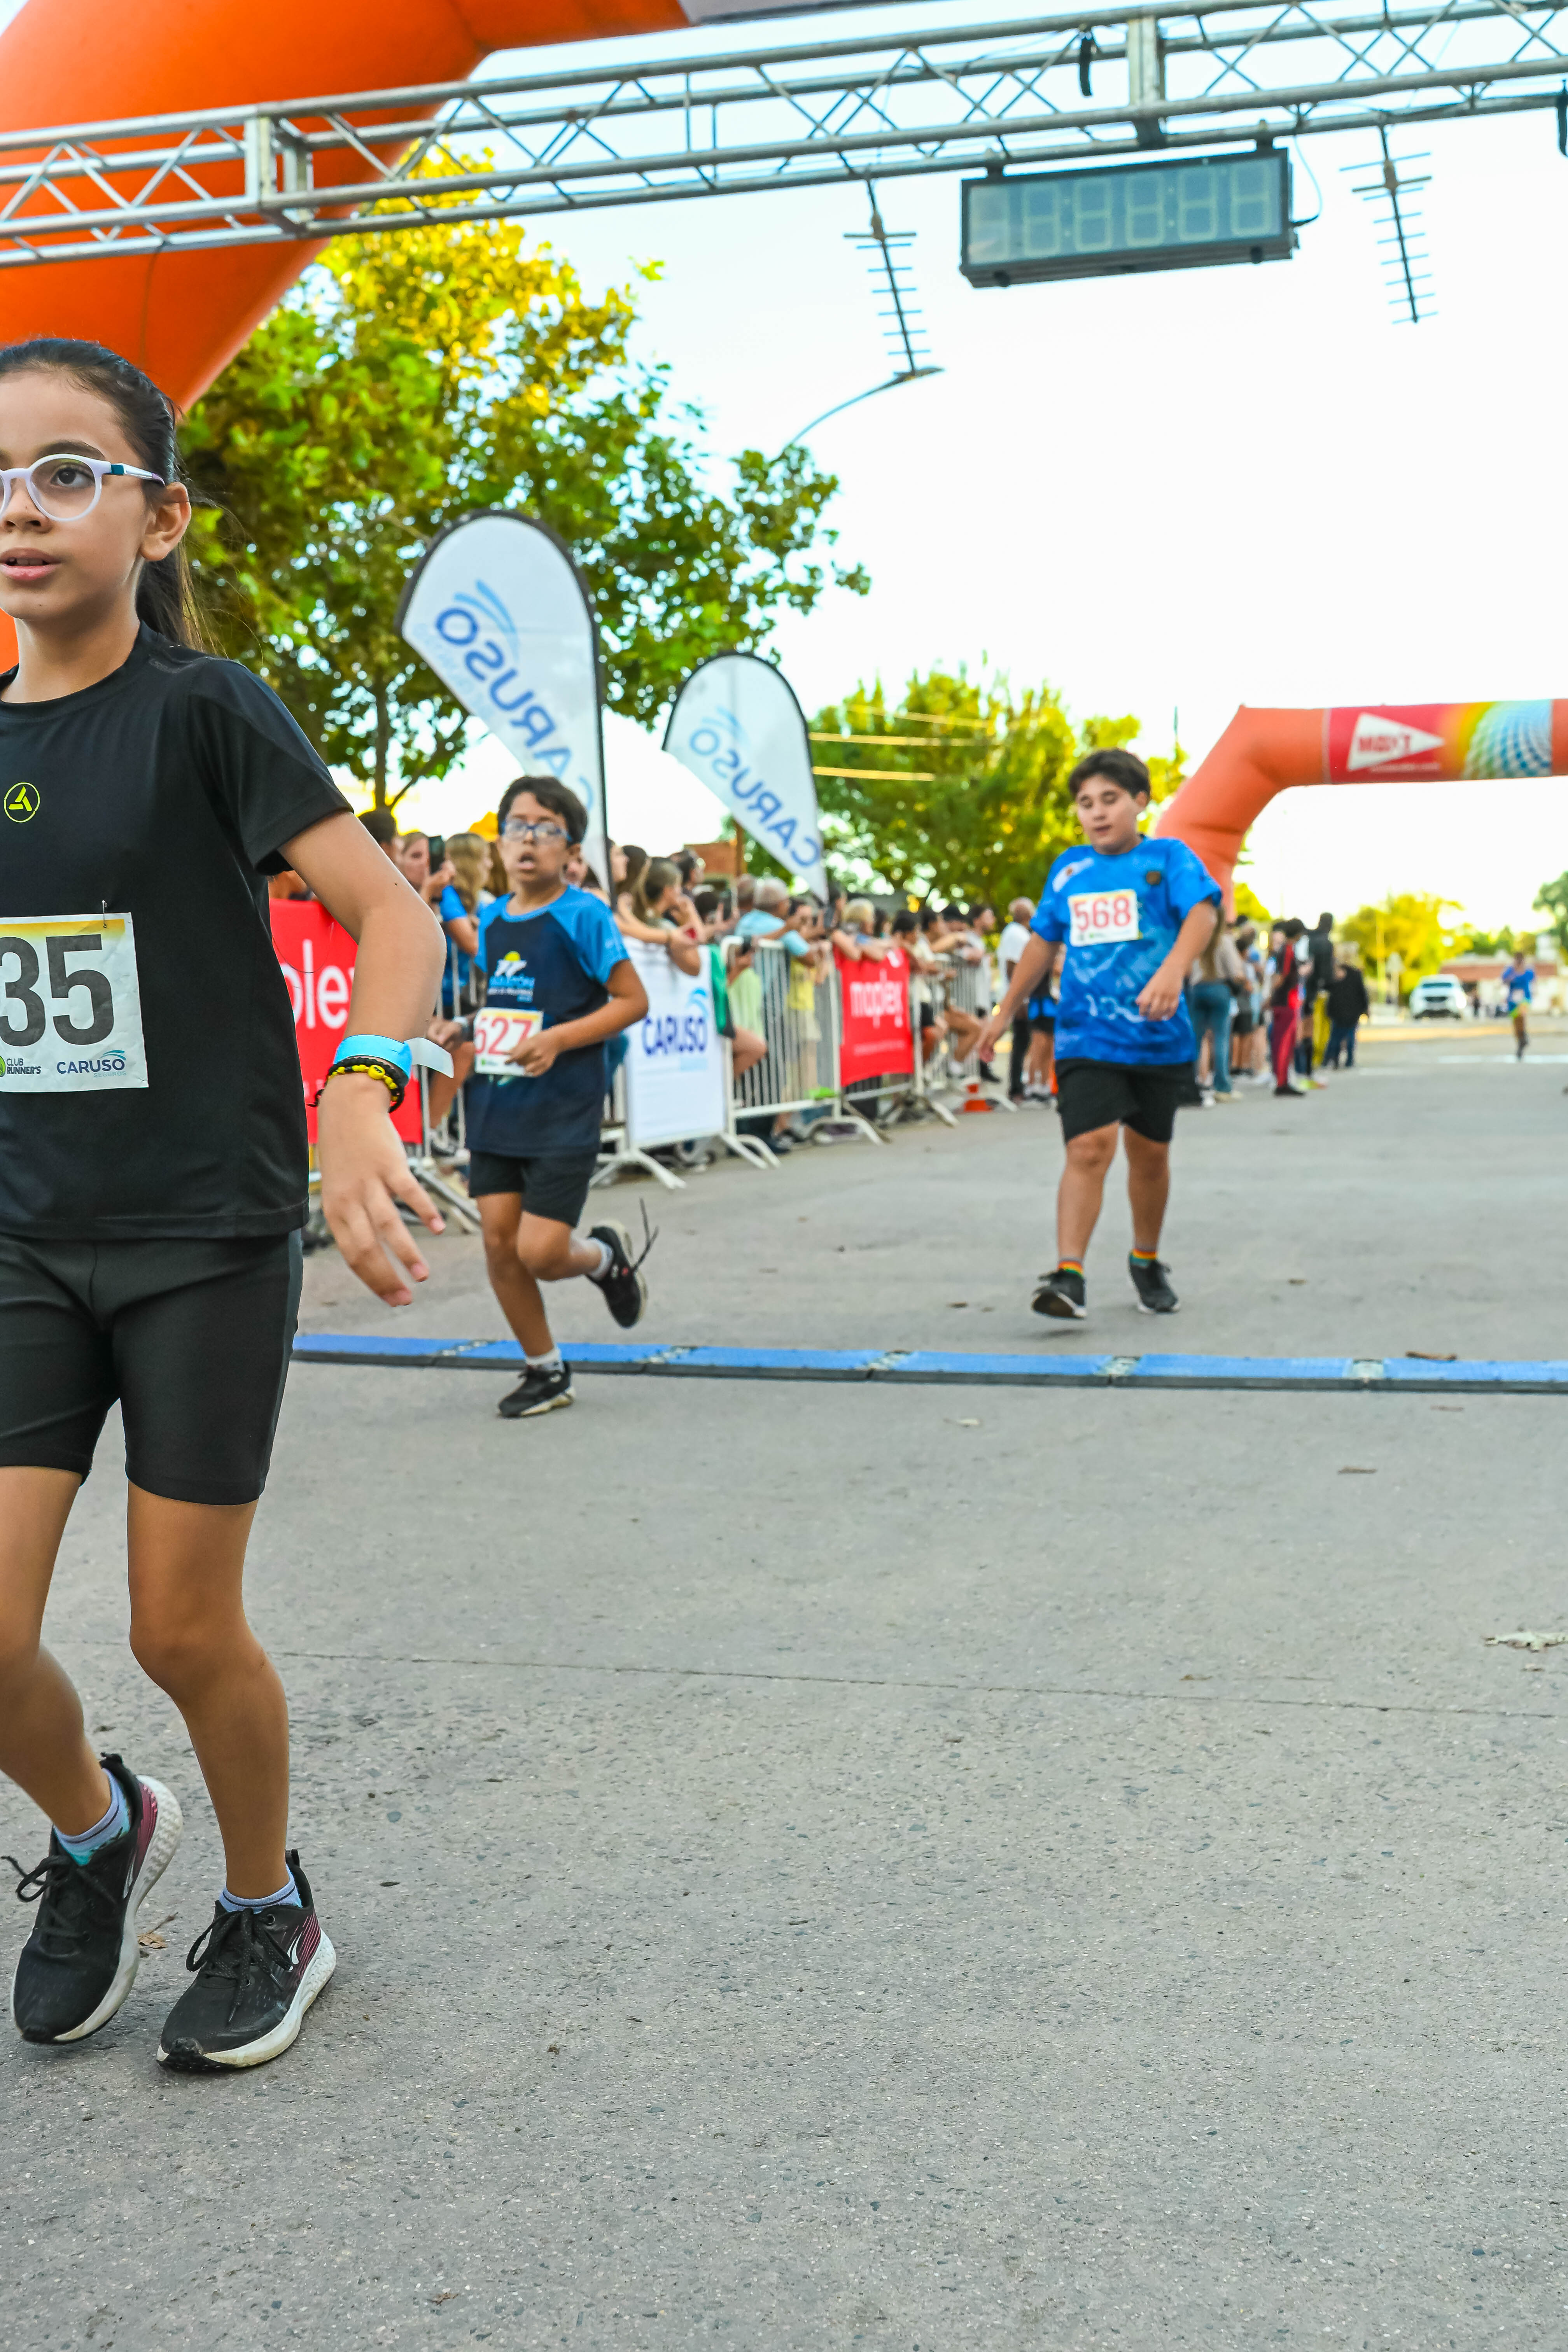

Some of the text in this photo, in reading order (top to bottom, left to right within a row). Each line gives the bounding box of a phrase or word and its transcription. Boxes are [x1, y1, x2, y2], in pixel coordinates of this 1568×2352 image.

[1074, 896, 1131, 932] 568
[642, 1016, 708, 1055] CARUSO
[57, 1059, 125, 1074] CARUSO
